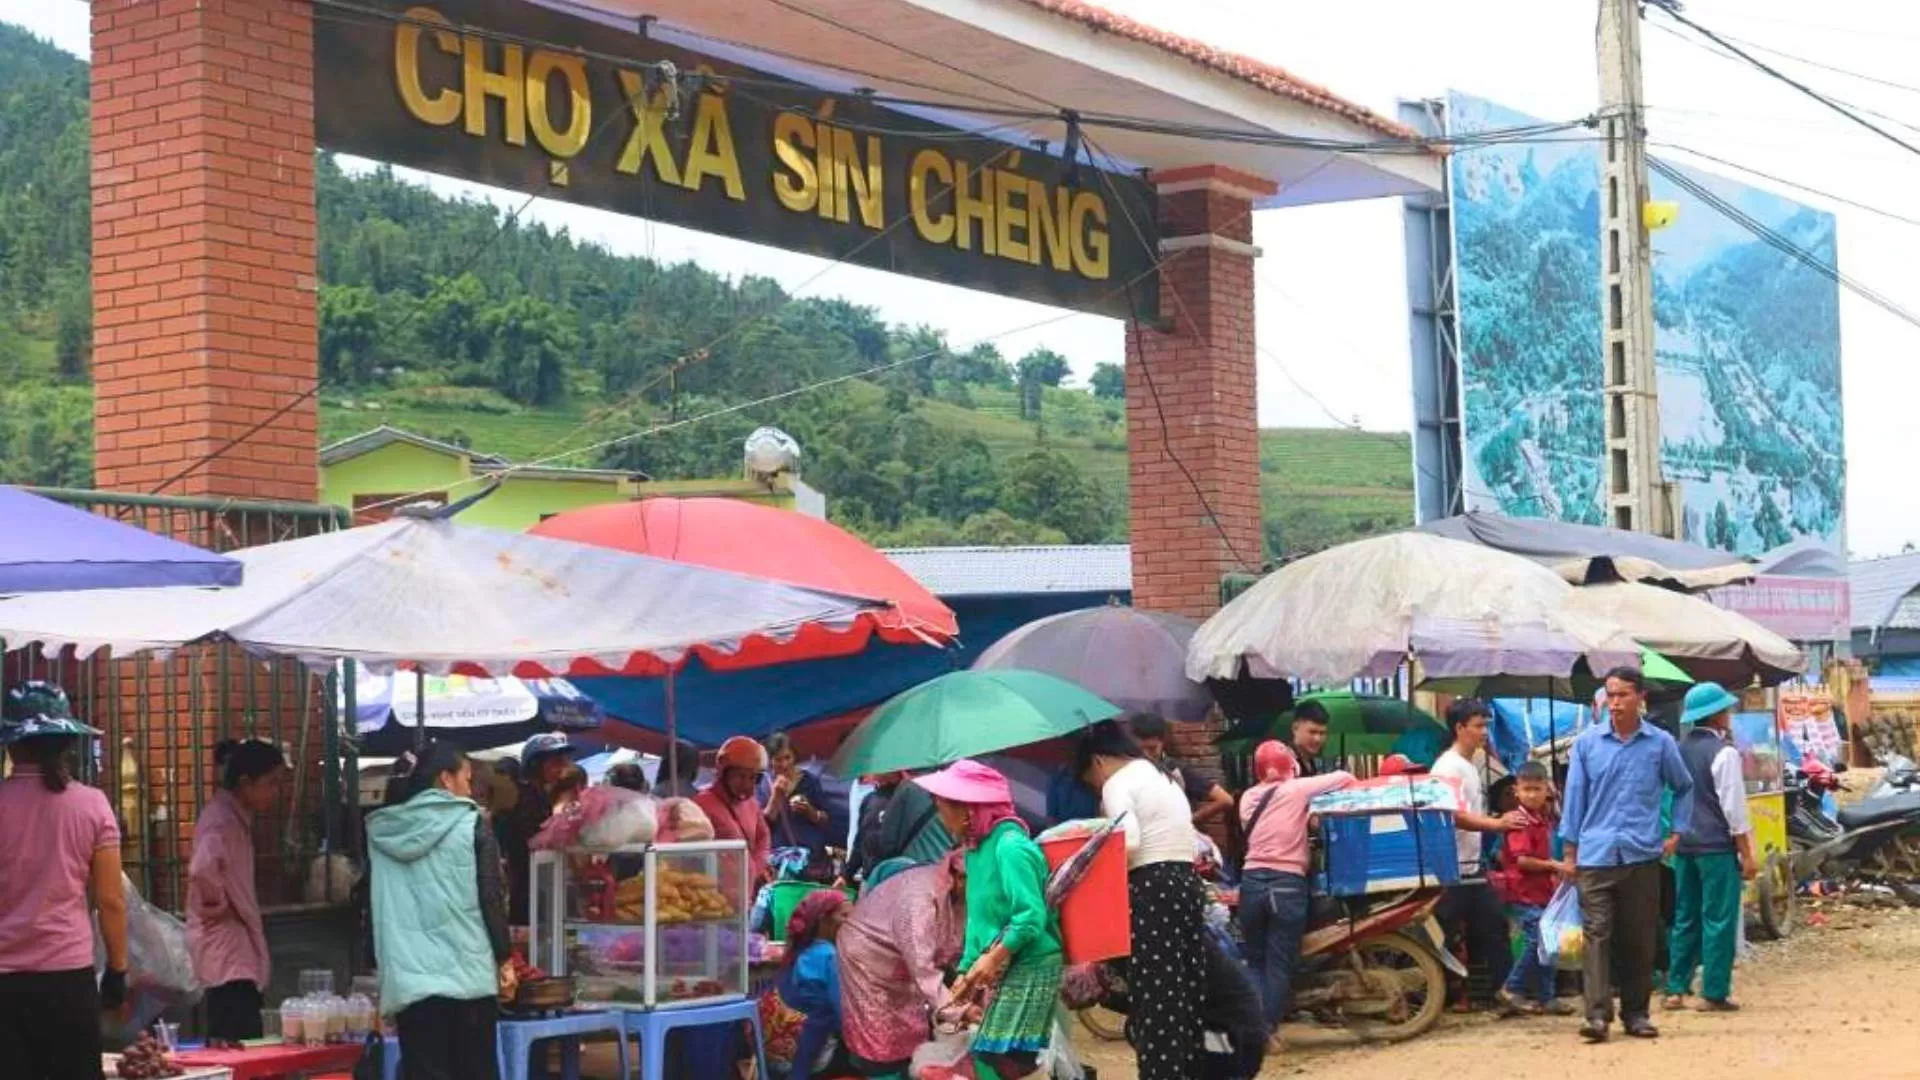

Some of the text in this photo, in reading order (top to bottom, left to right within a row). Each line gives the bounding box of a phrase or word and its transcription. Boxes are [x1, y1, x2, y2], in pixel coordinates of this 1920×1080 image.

[395, 6, 1109, 279] CHỢ XÃ SÍN CHÉNG
